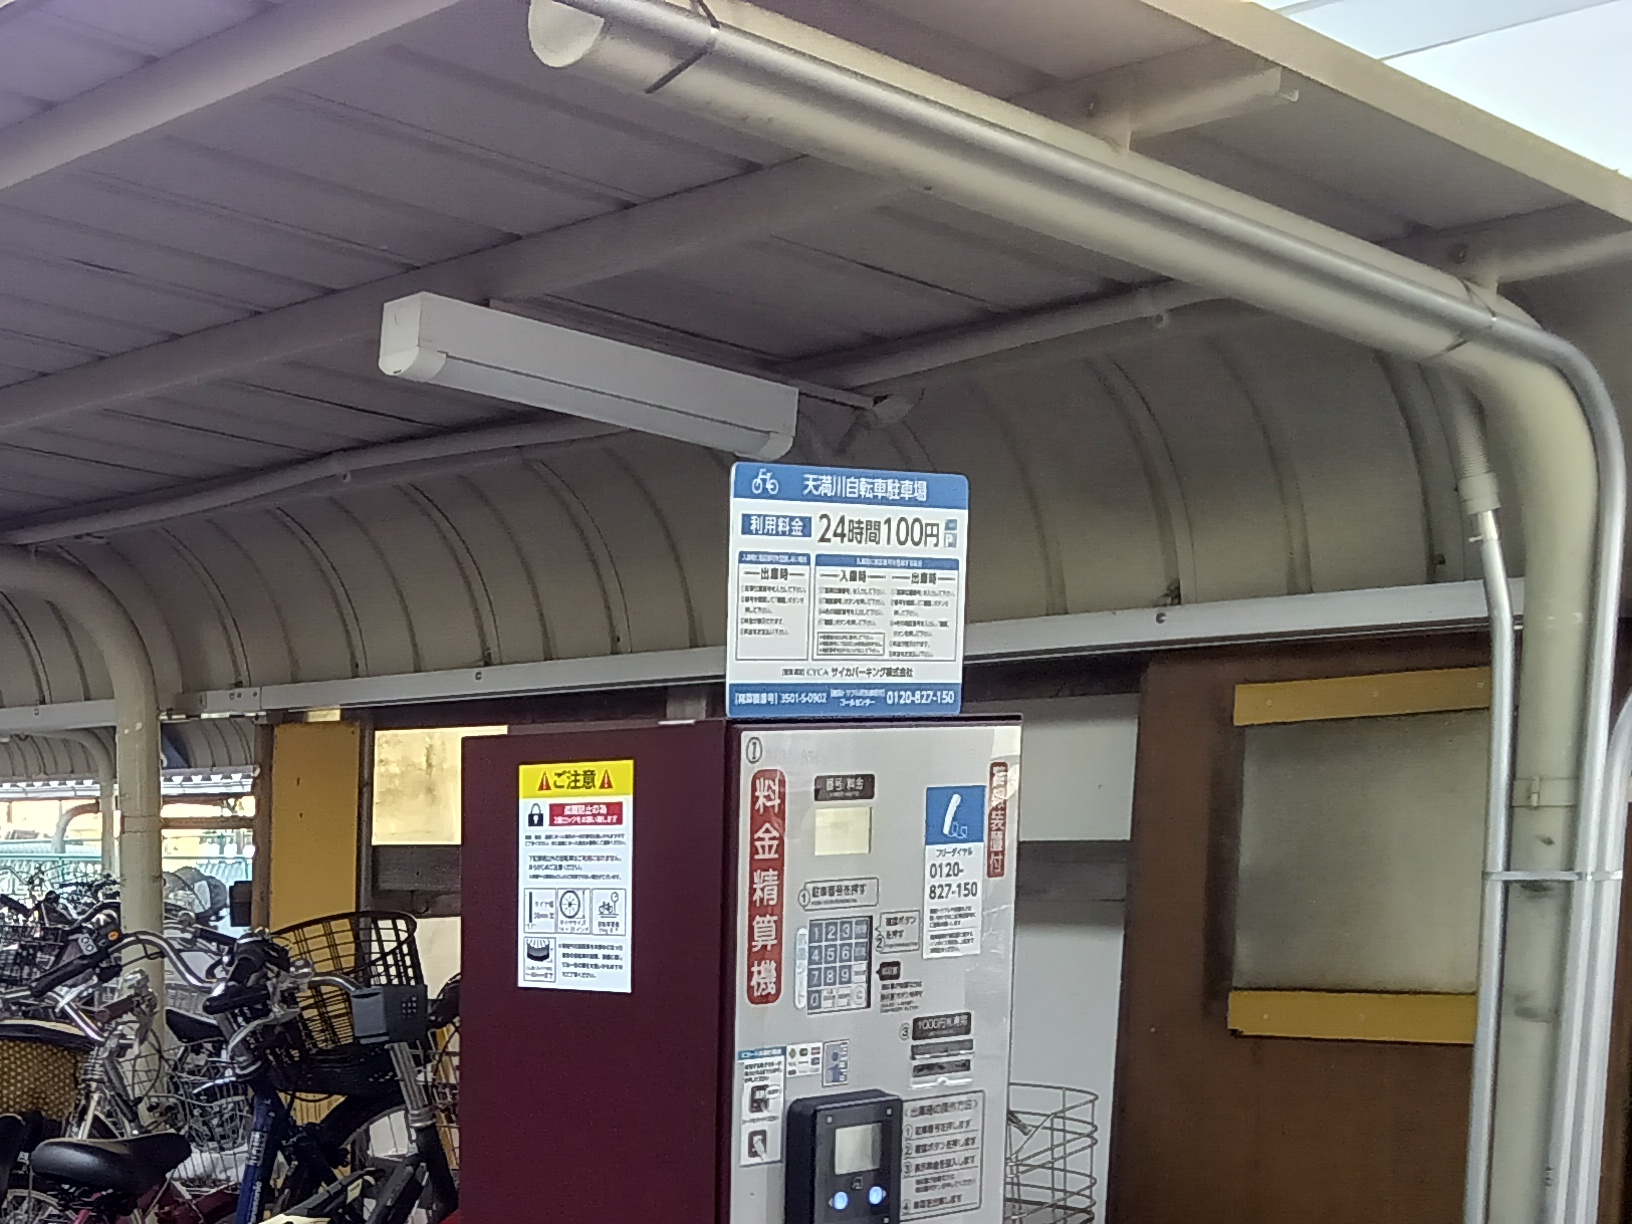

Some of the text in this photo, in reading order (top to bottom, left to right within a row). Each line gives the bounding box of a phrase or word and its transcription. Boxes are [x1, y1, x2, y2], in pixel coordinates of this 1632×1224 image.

[803, 473, 927, 502] 天満川自転車駐車場
[749, 514, 940, 547] 利用料金 24時間100円
[886, 691, 955, 705] 0120-827-150
[554, 769, 596, 790] ご注意
[936, 848, 973, 858] フリーダイヤル
[930, 862, 964, 879] 0120-
[750, 777, 780, 997] 料金精算機
[928, 882, 978, 900] 827-150
[814, 927, 820, 940] 1
[827, 926, 836, 939] 2
[842, 924, 850, 937] 3
[811, 950, 820, 961] 4
[827, 948, 835, 959] 5
[842, 946, 850, 959] 6
[811, 971, 819, 984] 7
[826, 969, 834, 983] 8
[841, 969, 849, 981] 9
[811, 993, 819, 1006] 0
